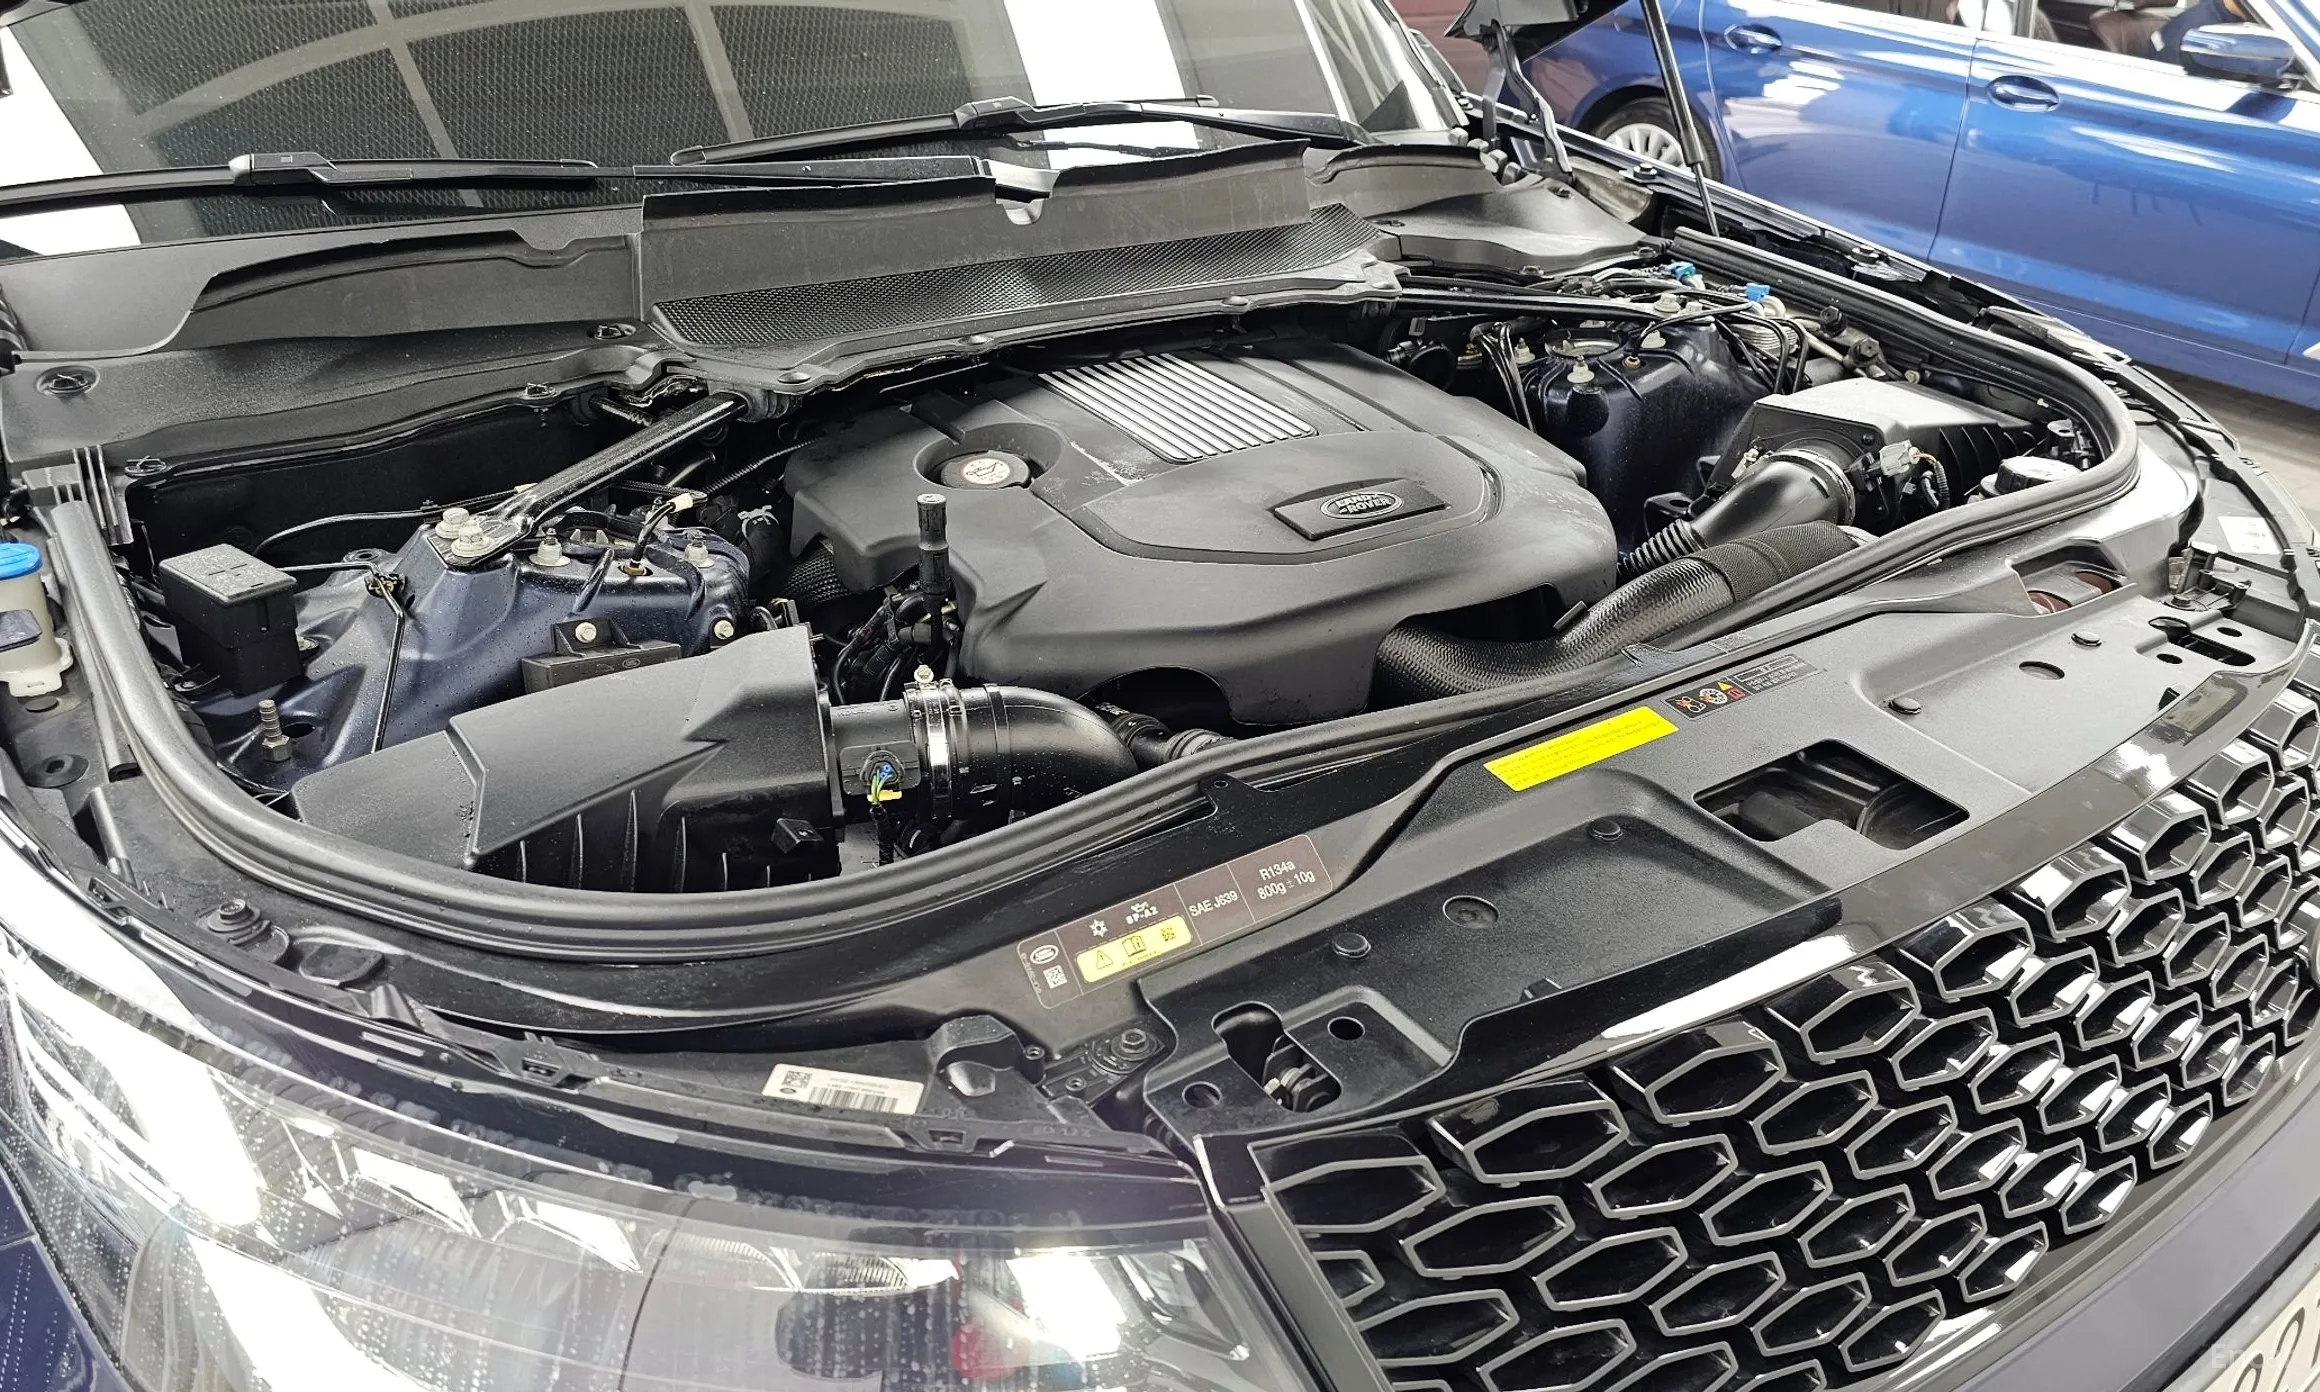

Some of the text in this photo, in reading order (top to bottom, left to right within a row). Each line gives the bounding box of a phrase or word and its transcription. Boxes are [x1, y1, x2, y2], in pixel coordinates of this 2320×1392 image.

[1335, 494, 1373, 509] LAND
[1346, 498, 1392, 514] ROVER
[1258, 860, 1296, 881] R134a
[1257, 882, 1287, 900] 800g
[1293, 870, 1316, 885] 10g
[1188, 890, 1238, 917] SAE J639
